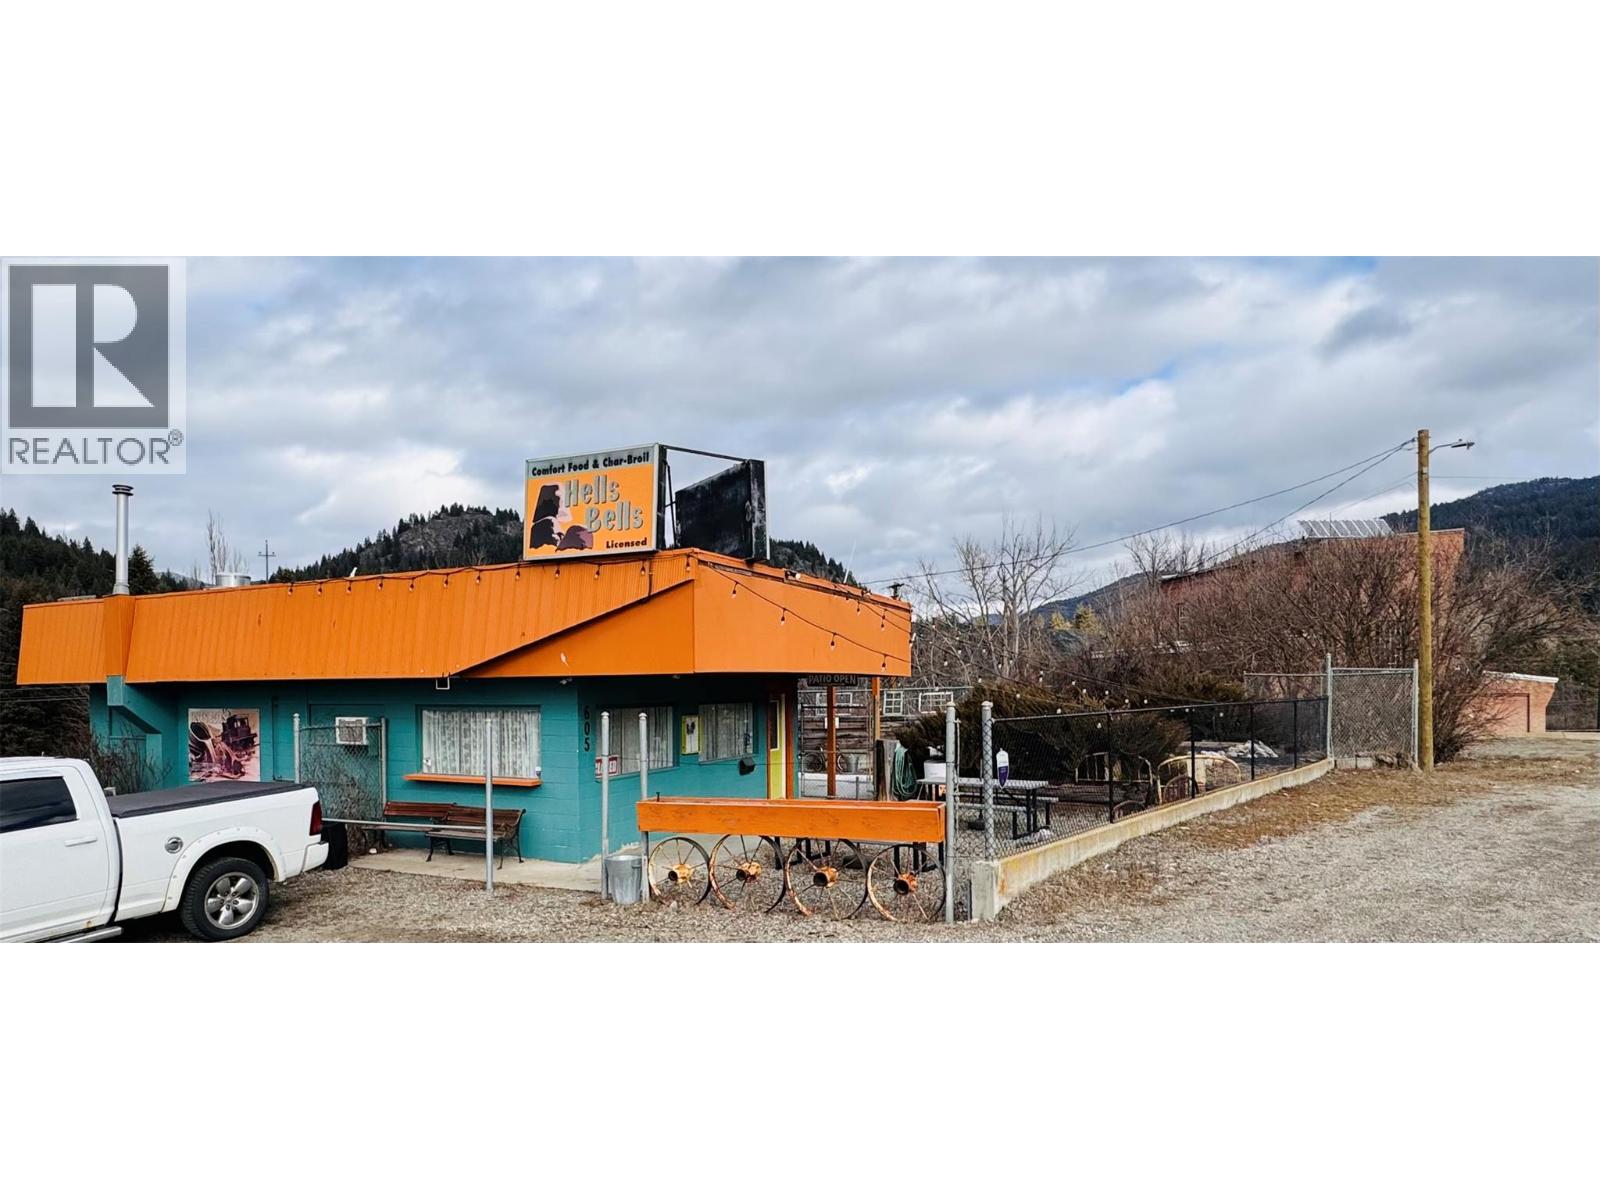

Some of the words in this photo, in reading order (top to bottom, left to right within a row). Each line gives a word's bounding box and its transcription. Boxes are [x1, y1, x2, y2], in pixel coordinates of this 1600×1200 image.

[532, 464, 565, 476] Comfort
[567, 460, 589, 472] Food
[592, 459, 600, 469] &
[603, 452, 649, 467] Char-Broil
[564, 475, 620, 507] Hells
[585, 501, 644, 533] Bells
[606, 538, 647, 549] Licensed
[808, 674, 832, 684] PATIO
[833, 674, 857, 685] OPEN
